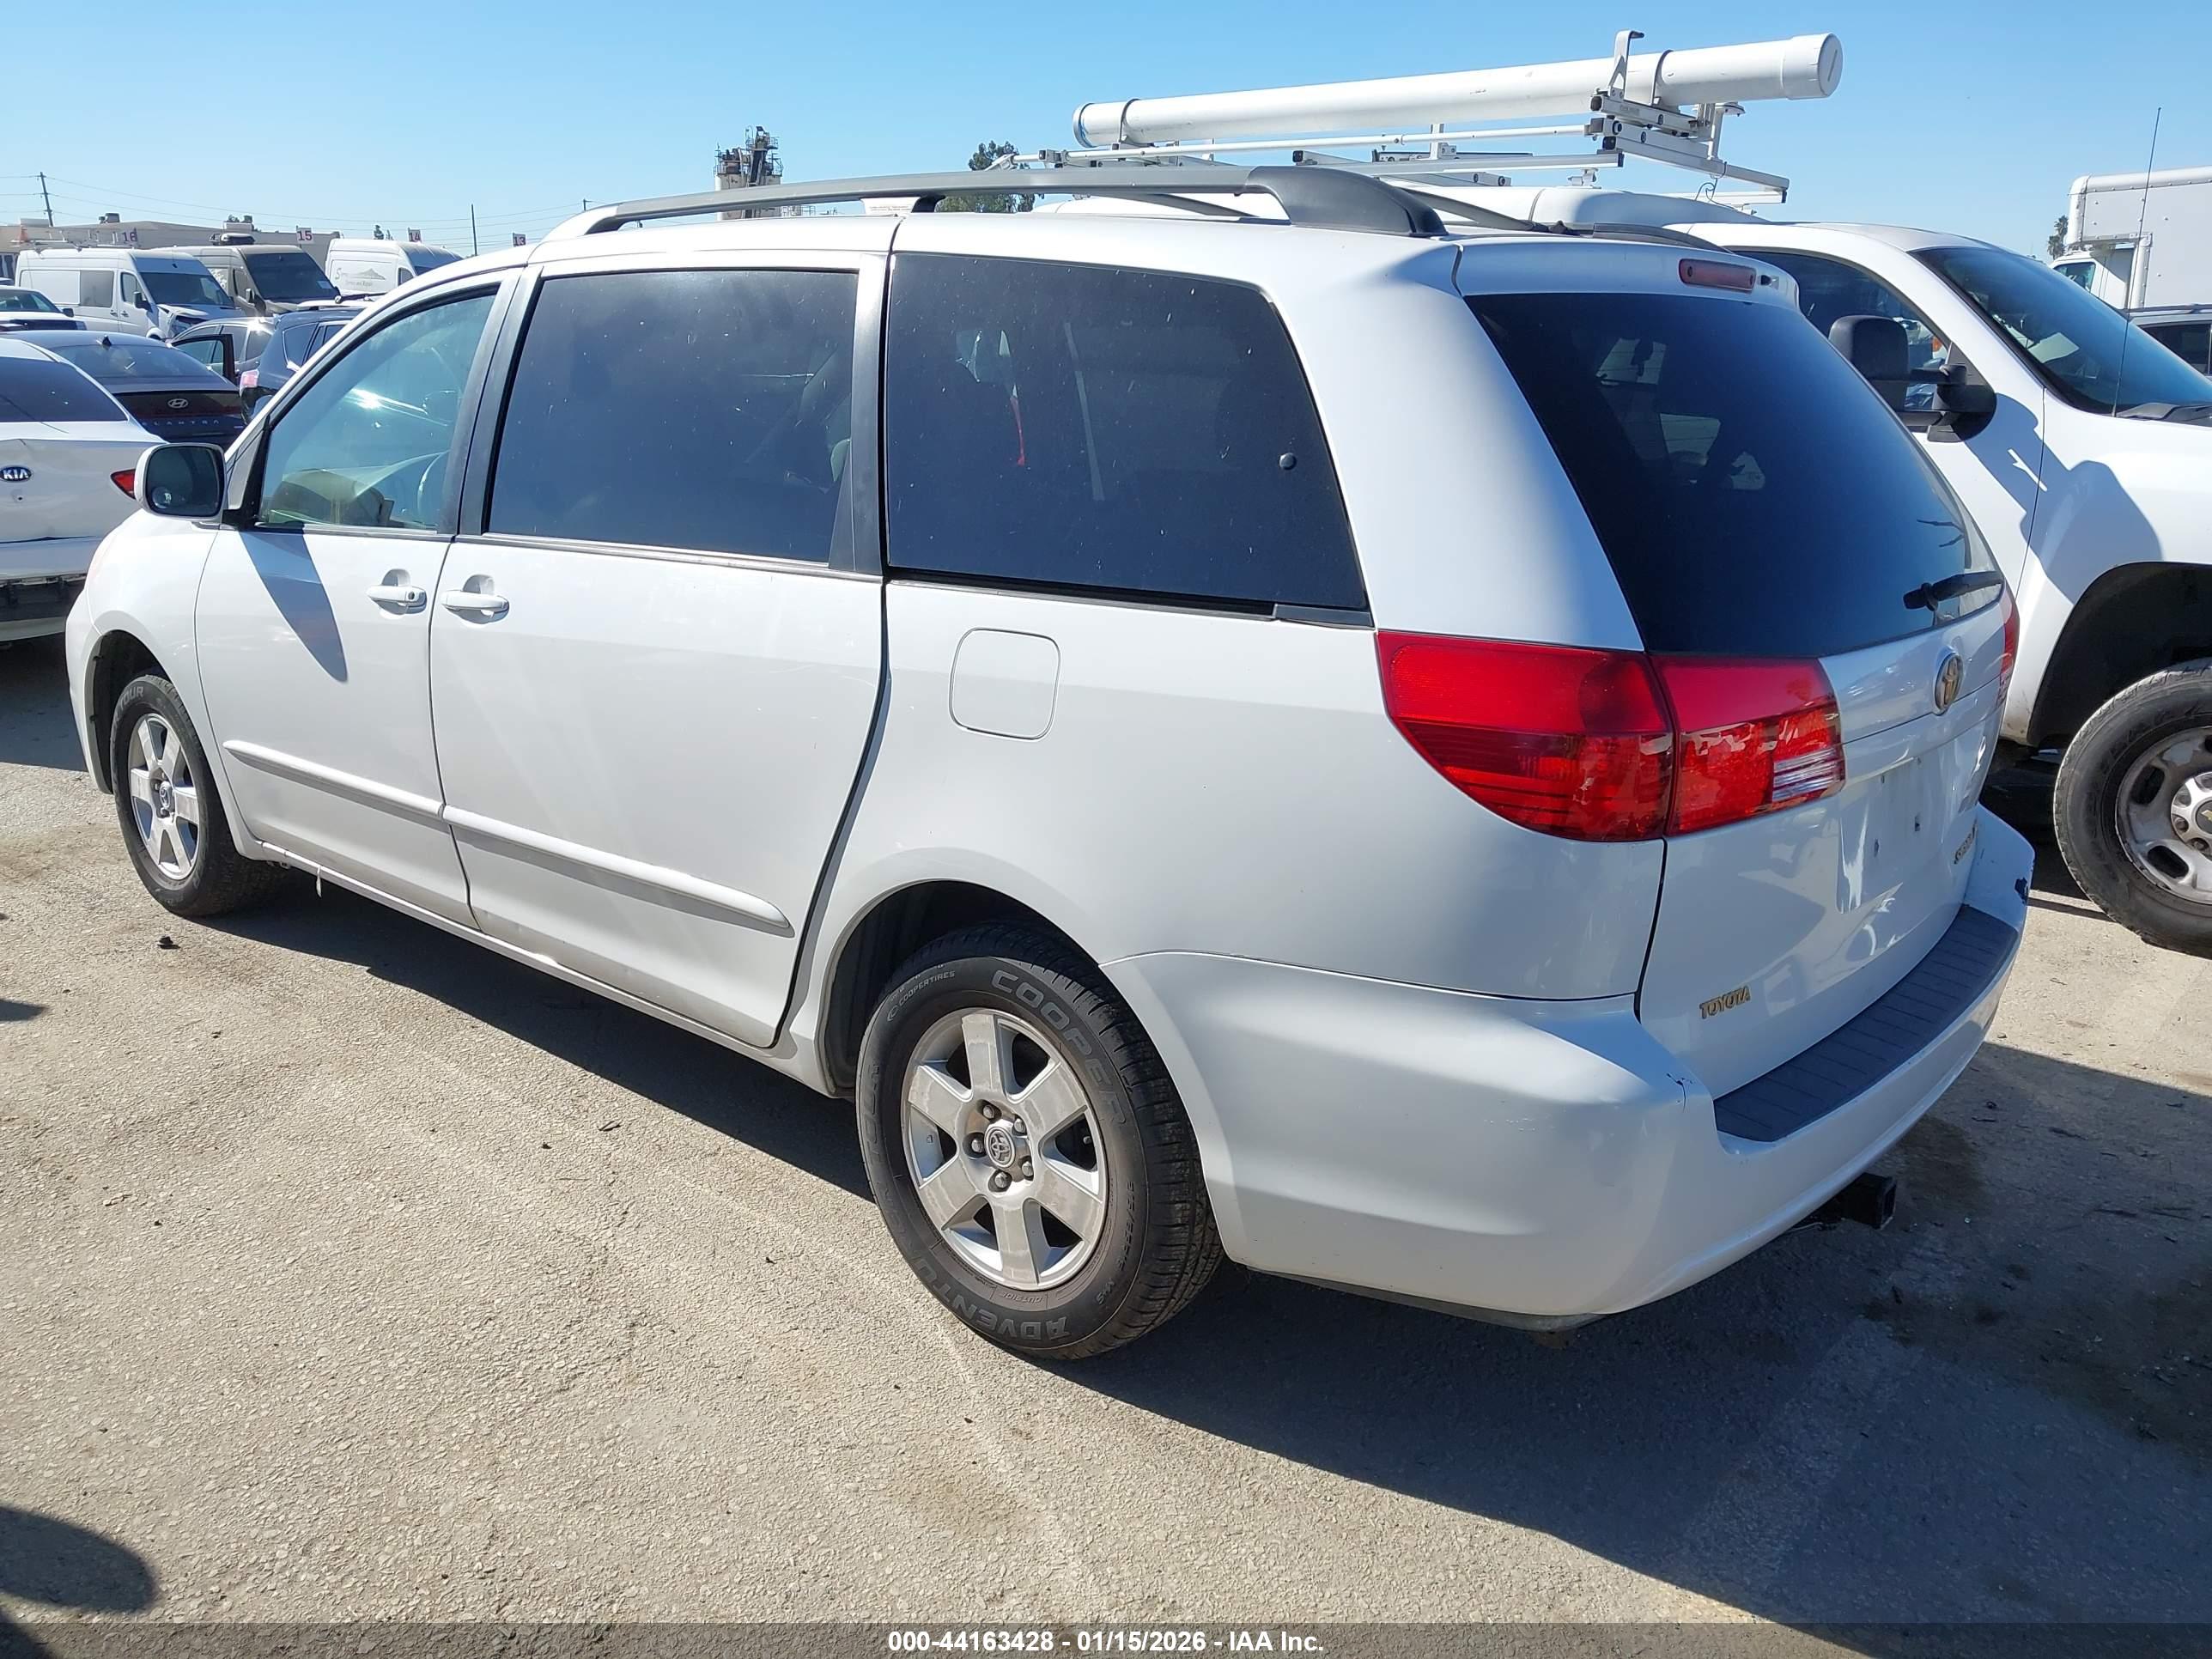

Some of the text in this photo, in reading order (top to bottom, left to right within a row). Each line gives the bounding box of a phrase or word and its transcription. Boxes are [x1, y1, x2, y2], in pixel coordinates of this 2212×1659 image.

[296, 230, 313, 241] 15
[410, 232, 421, 241] 14
[514, 235, 526, 246] 13
[3, 469, 29, 479] KIA
[1699, 985, 1751, 1019] TOYOTA
[992, 969, 1127, 1126] COOPER
